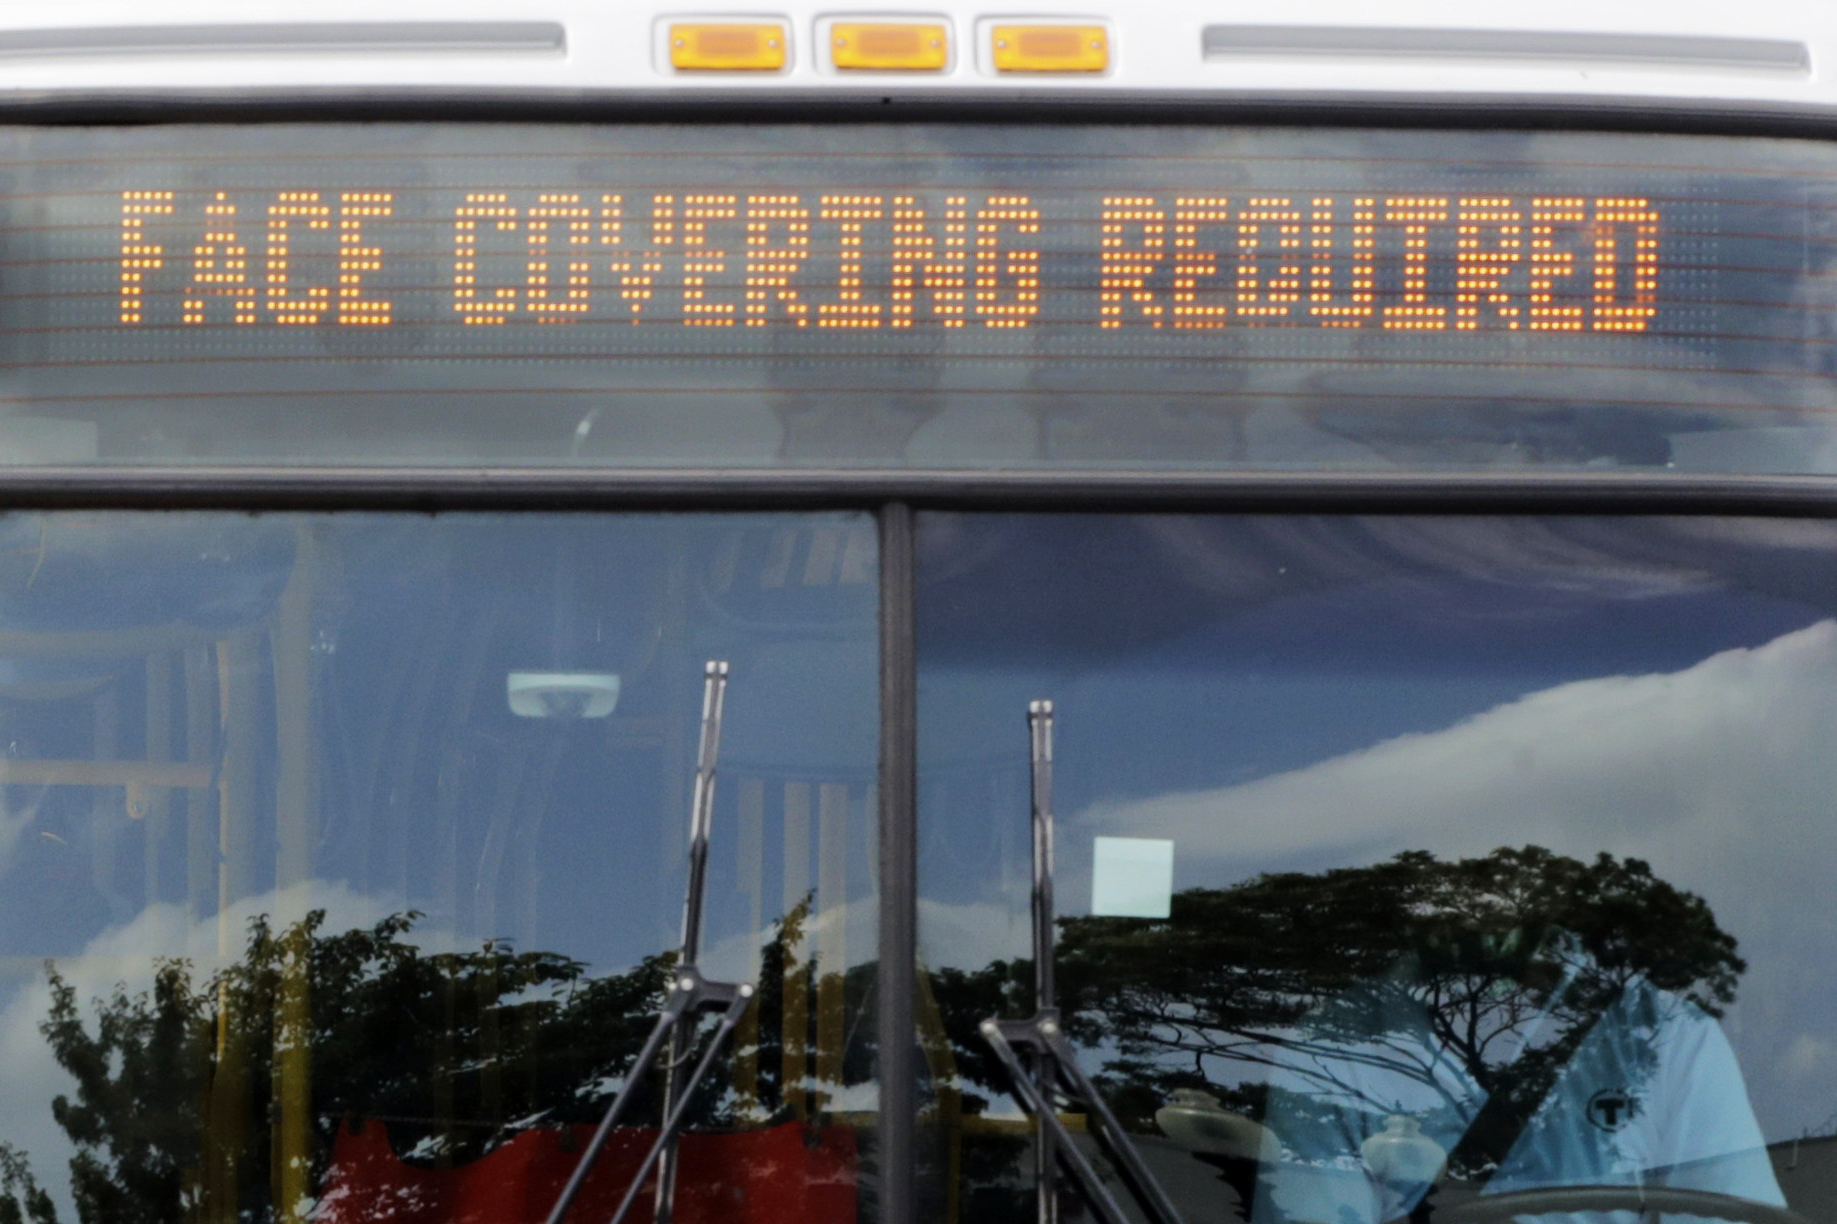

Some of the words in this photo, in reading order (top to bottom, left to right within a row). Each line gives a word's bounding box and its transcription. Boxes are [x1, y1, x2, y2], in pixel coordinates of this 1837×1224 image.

[120, 191, 393, 325] FACE
[454, 193, 1039, 328] COVERING
[1100, 196, 1659, 331] REQUIRED
